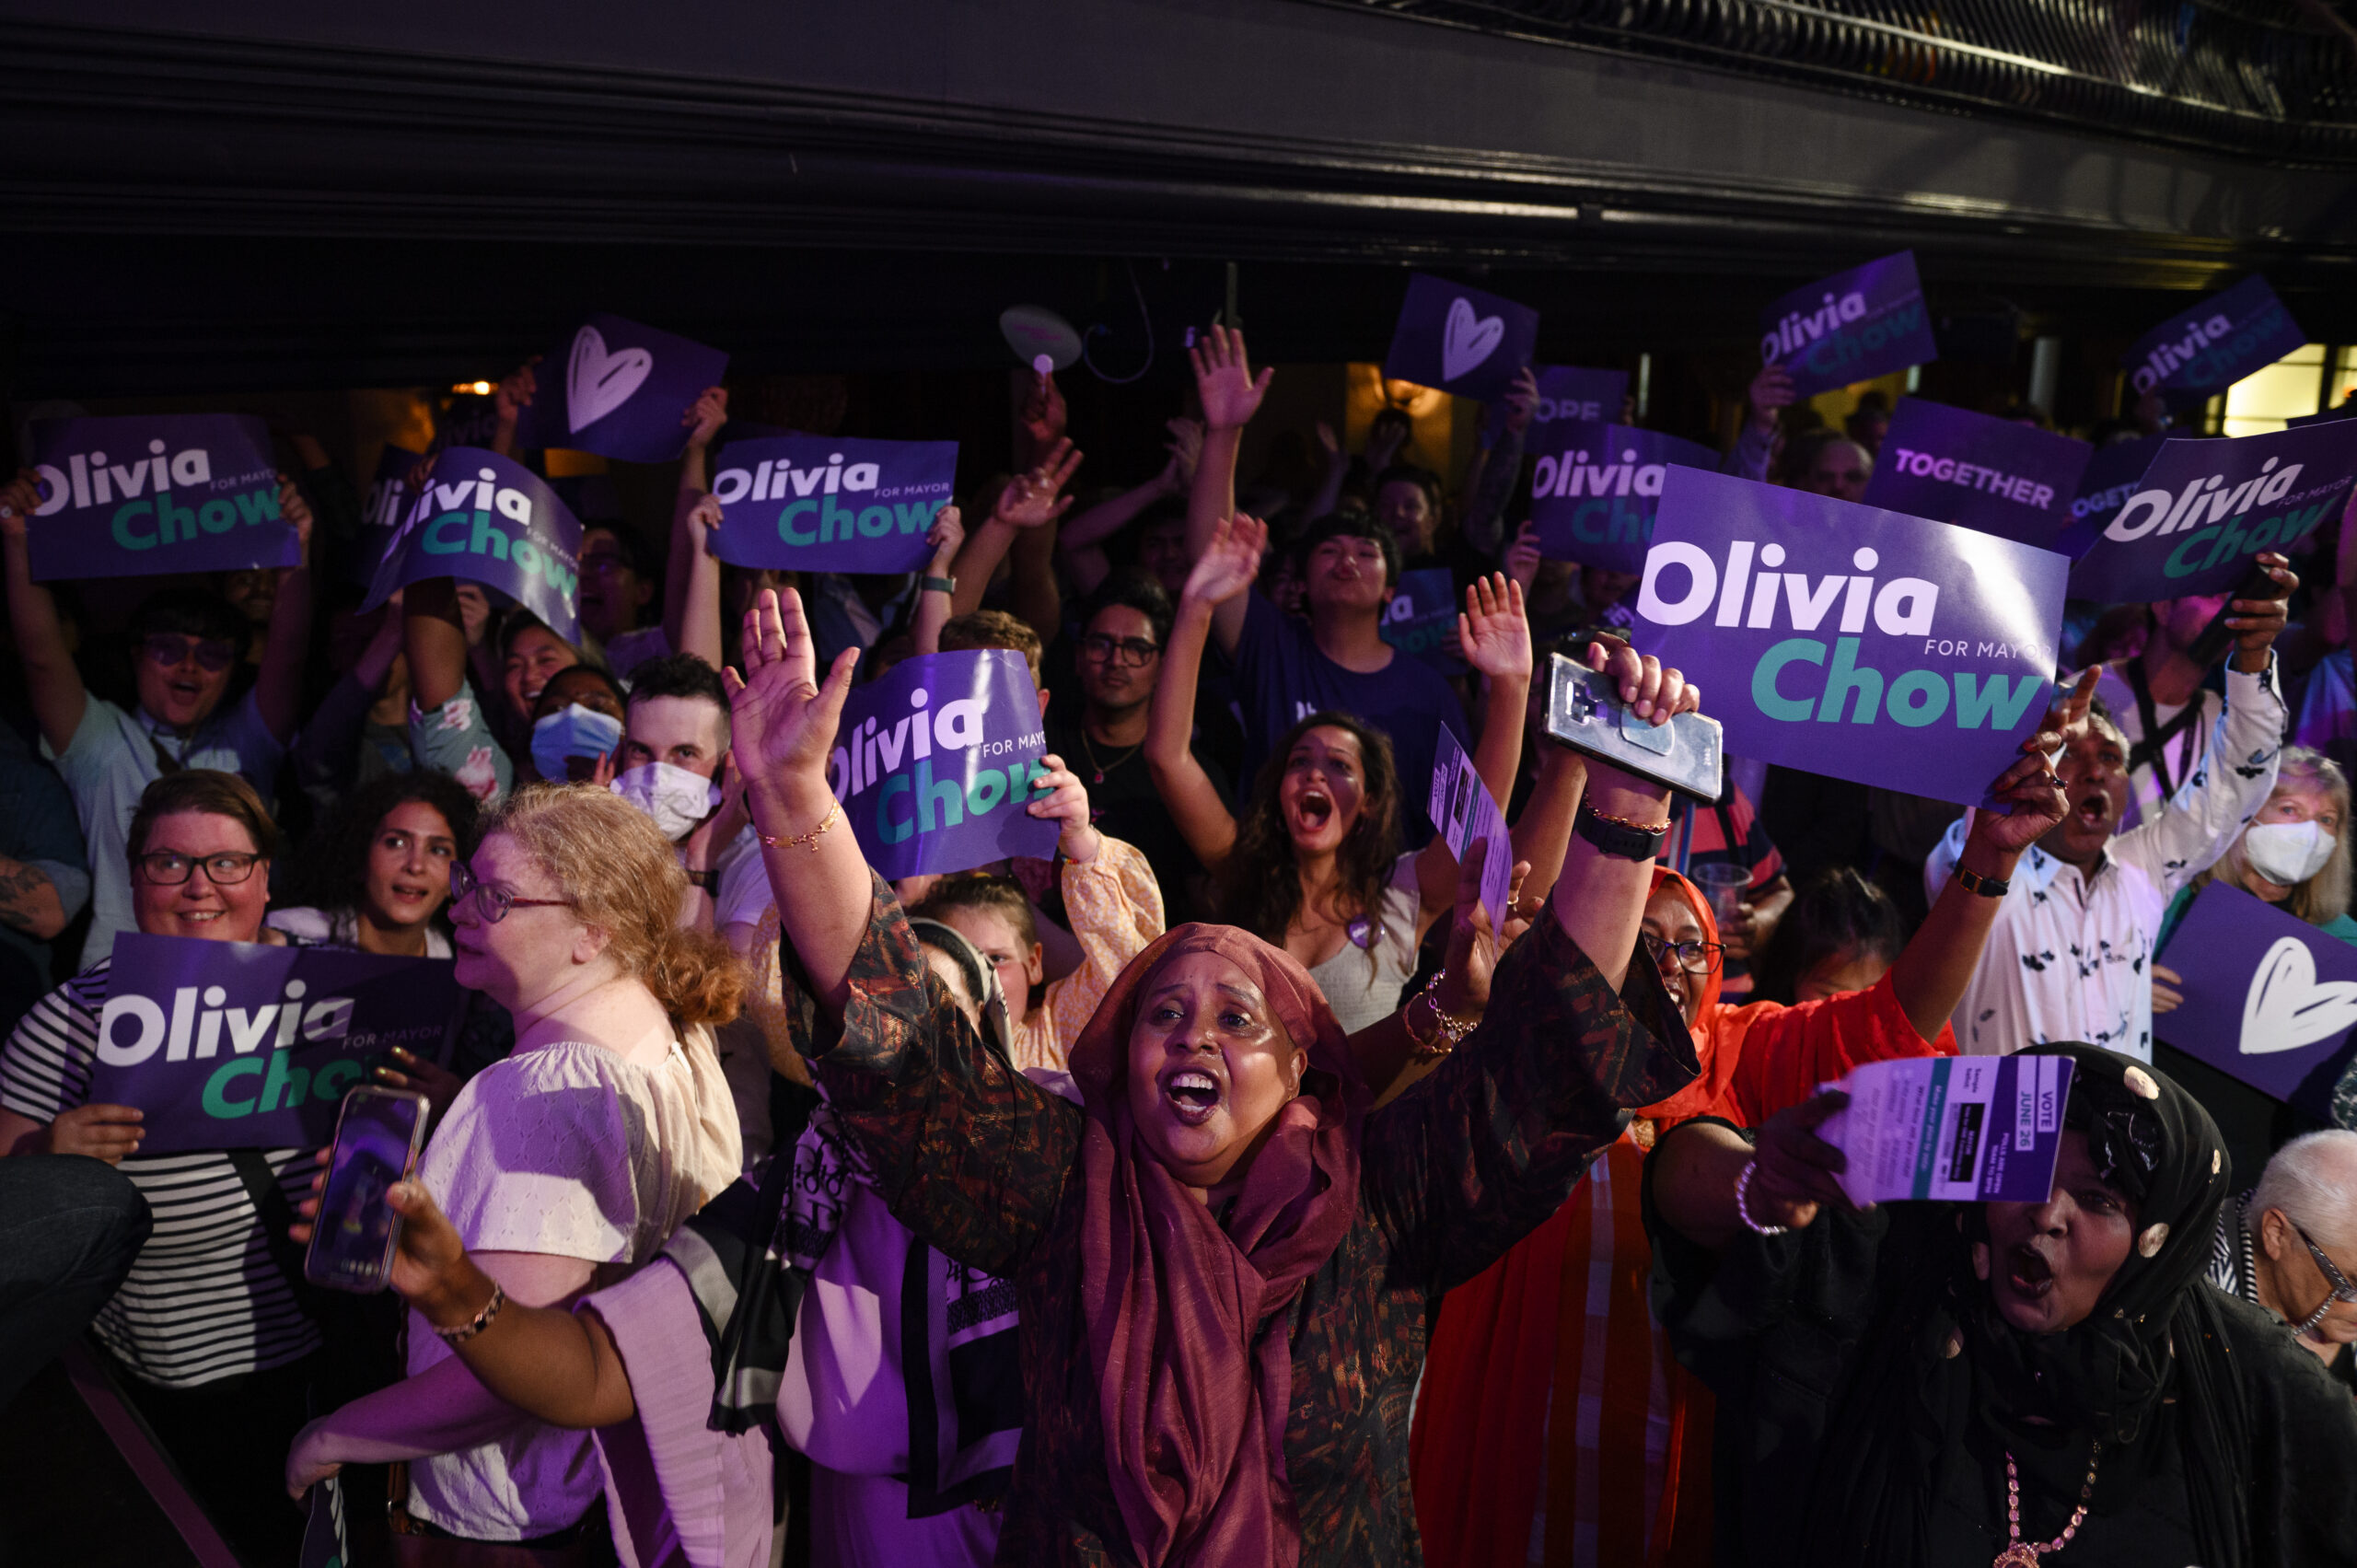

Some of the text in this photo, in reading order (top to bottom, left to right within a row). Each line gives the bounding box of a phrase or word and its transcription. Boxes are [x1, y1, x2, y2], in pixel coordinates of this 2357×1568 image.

[1760, 292, 1867, 369] Olivia
[1806, 303, 1922, 375] Chow
[2132, 314, 2232, 396] Olivia
[1534, 397, 1602, 424] OPE
[32, 438, 212, 517] Olivia
[210, 468, 277, 493] FOR MAYO
[713, 453, 879, 505] Olivia
[874, 482, 950, 499] FOR MAYOR
[1531, 448, 1666, 499] Olivia
[1895, 448, 2055, 510] TOGETHER
[2104, 457, 2305, 542] Olivia
[2277, 490, 2305, 508] FOR
[110, 493, 282, 551] Chow
[362, 479, 404, 527] Oli
[777, 494, 947, 546] Chow
[1572, 497, 1657, 544] Ch
[422, 509, 578, 597] Chow
[2164, 496, 2340, 578] Chow
[1636, 540, 1939, 635] Olivia
[1924, 640, 2051, 660] FOR MAYOR
[1751, 637, 2045, 730] Chow
[983, 738, 1013, 758] FOR
[877, 759, 1055, 845] Chow
[96, 979, 355, 1067] Olivia
[343, 1025, 444, 1050] FOR MAYOR
[2018, 1091, 2032, 1148] JUNE 26
[2040, 1091, 2054, 1128] VOTE
